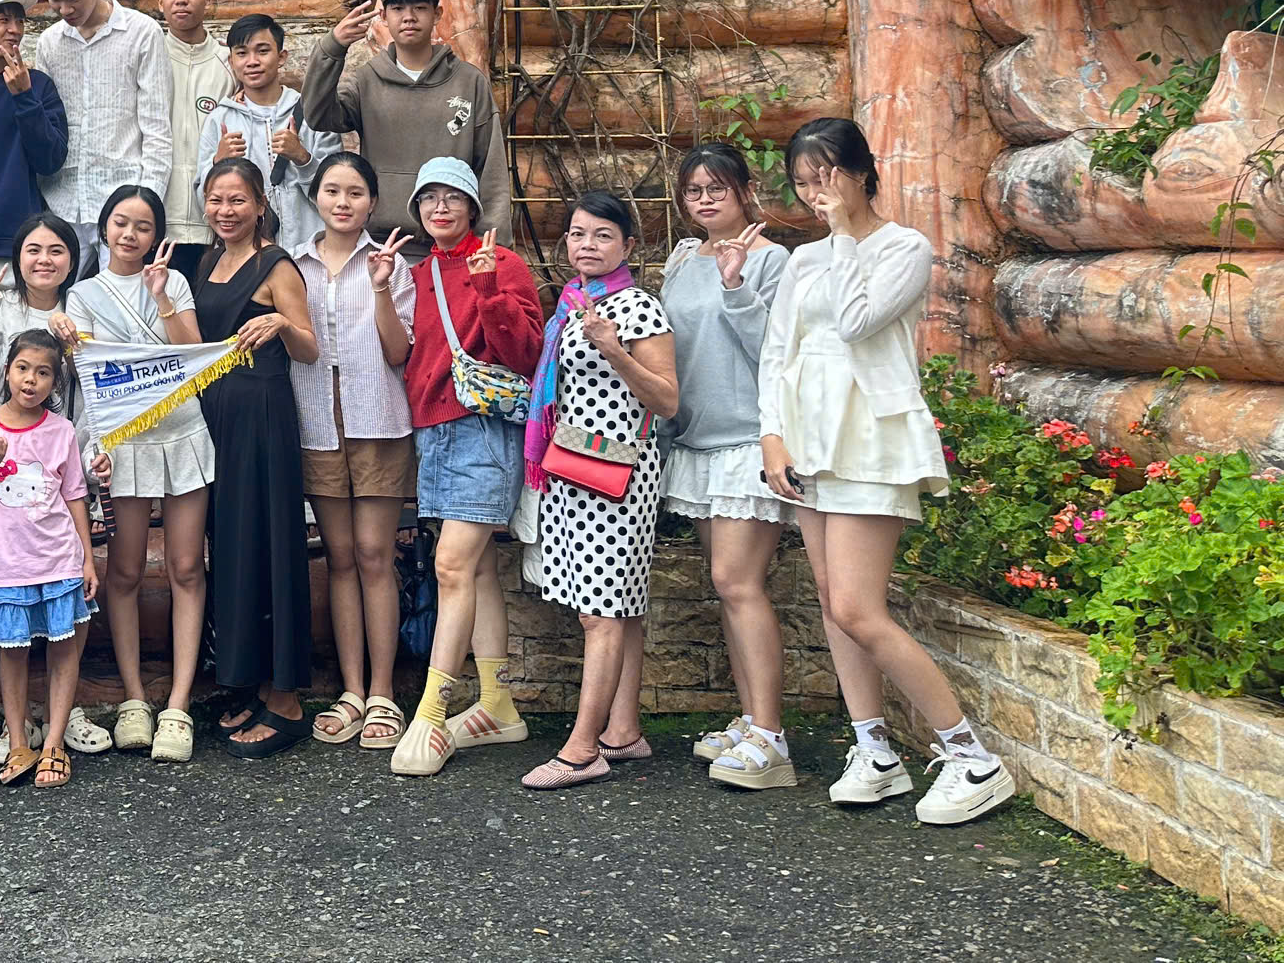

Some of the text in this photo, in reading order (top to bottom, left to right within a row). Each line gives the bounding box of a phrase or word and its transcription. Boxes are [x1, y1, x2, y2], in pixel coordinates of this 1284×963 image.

[133, 359, 185, 379] TRAVEL
[97, 391, 107, 399] DU
[123, 381, 152, 394] PHONG
